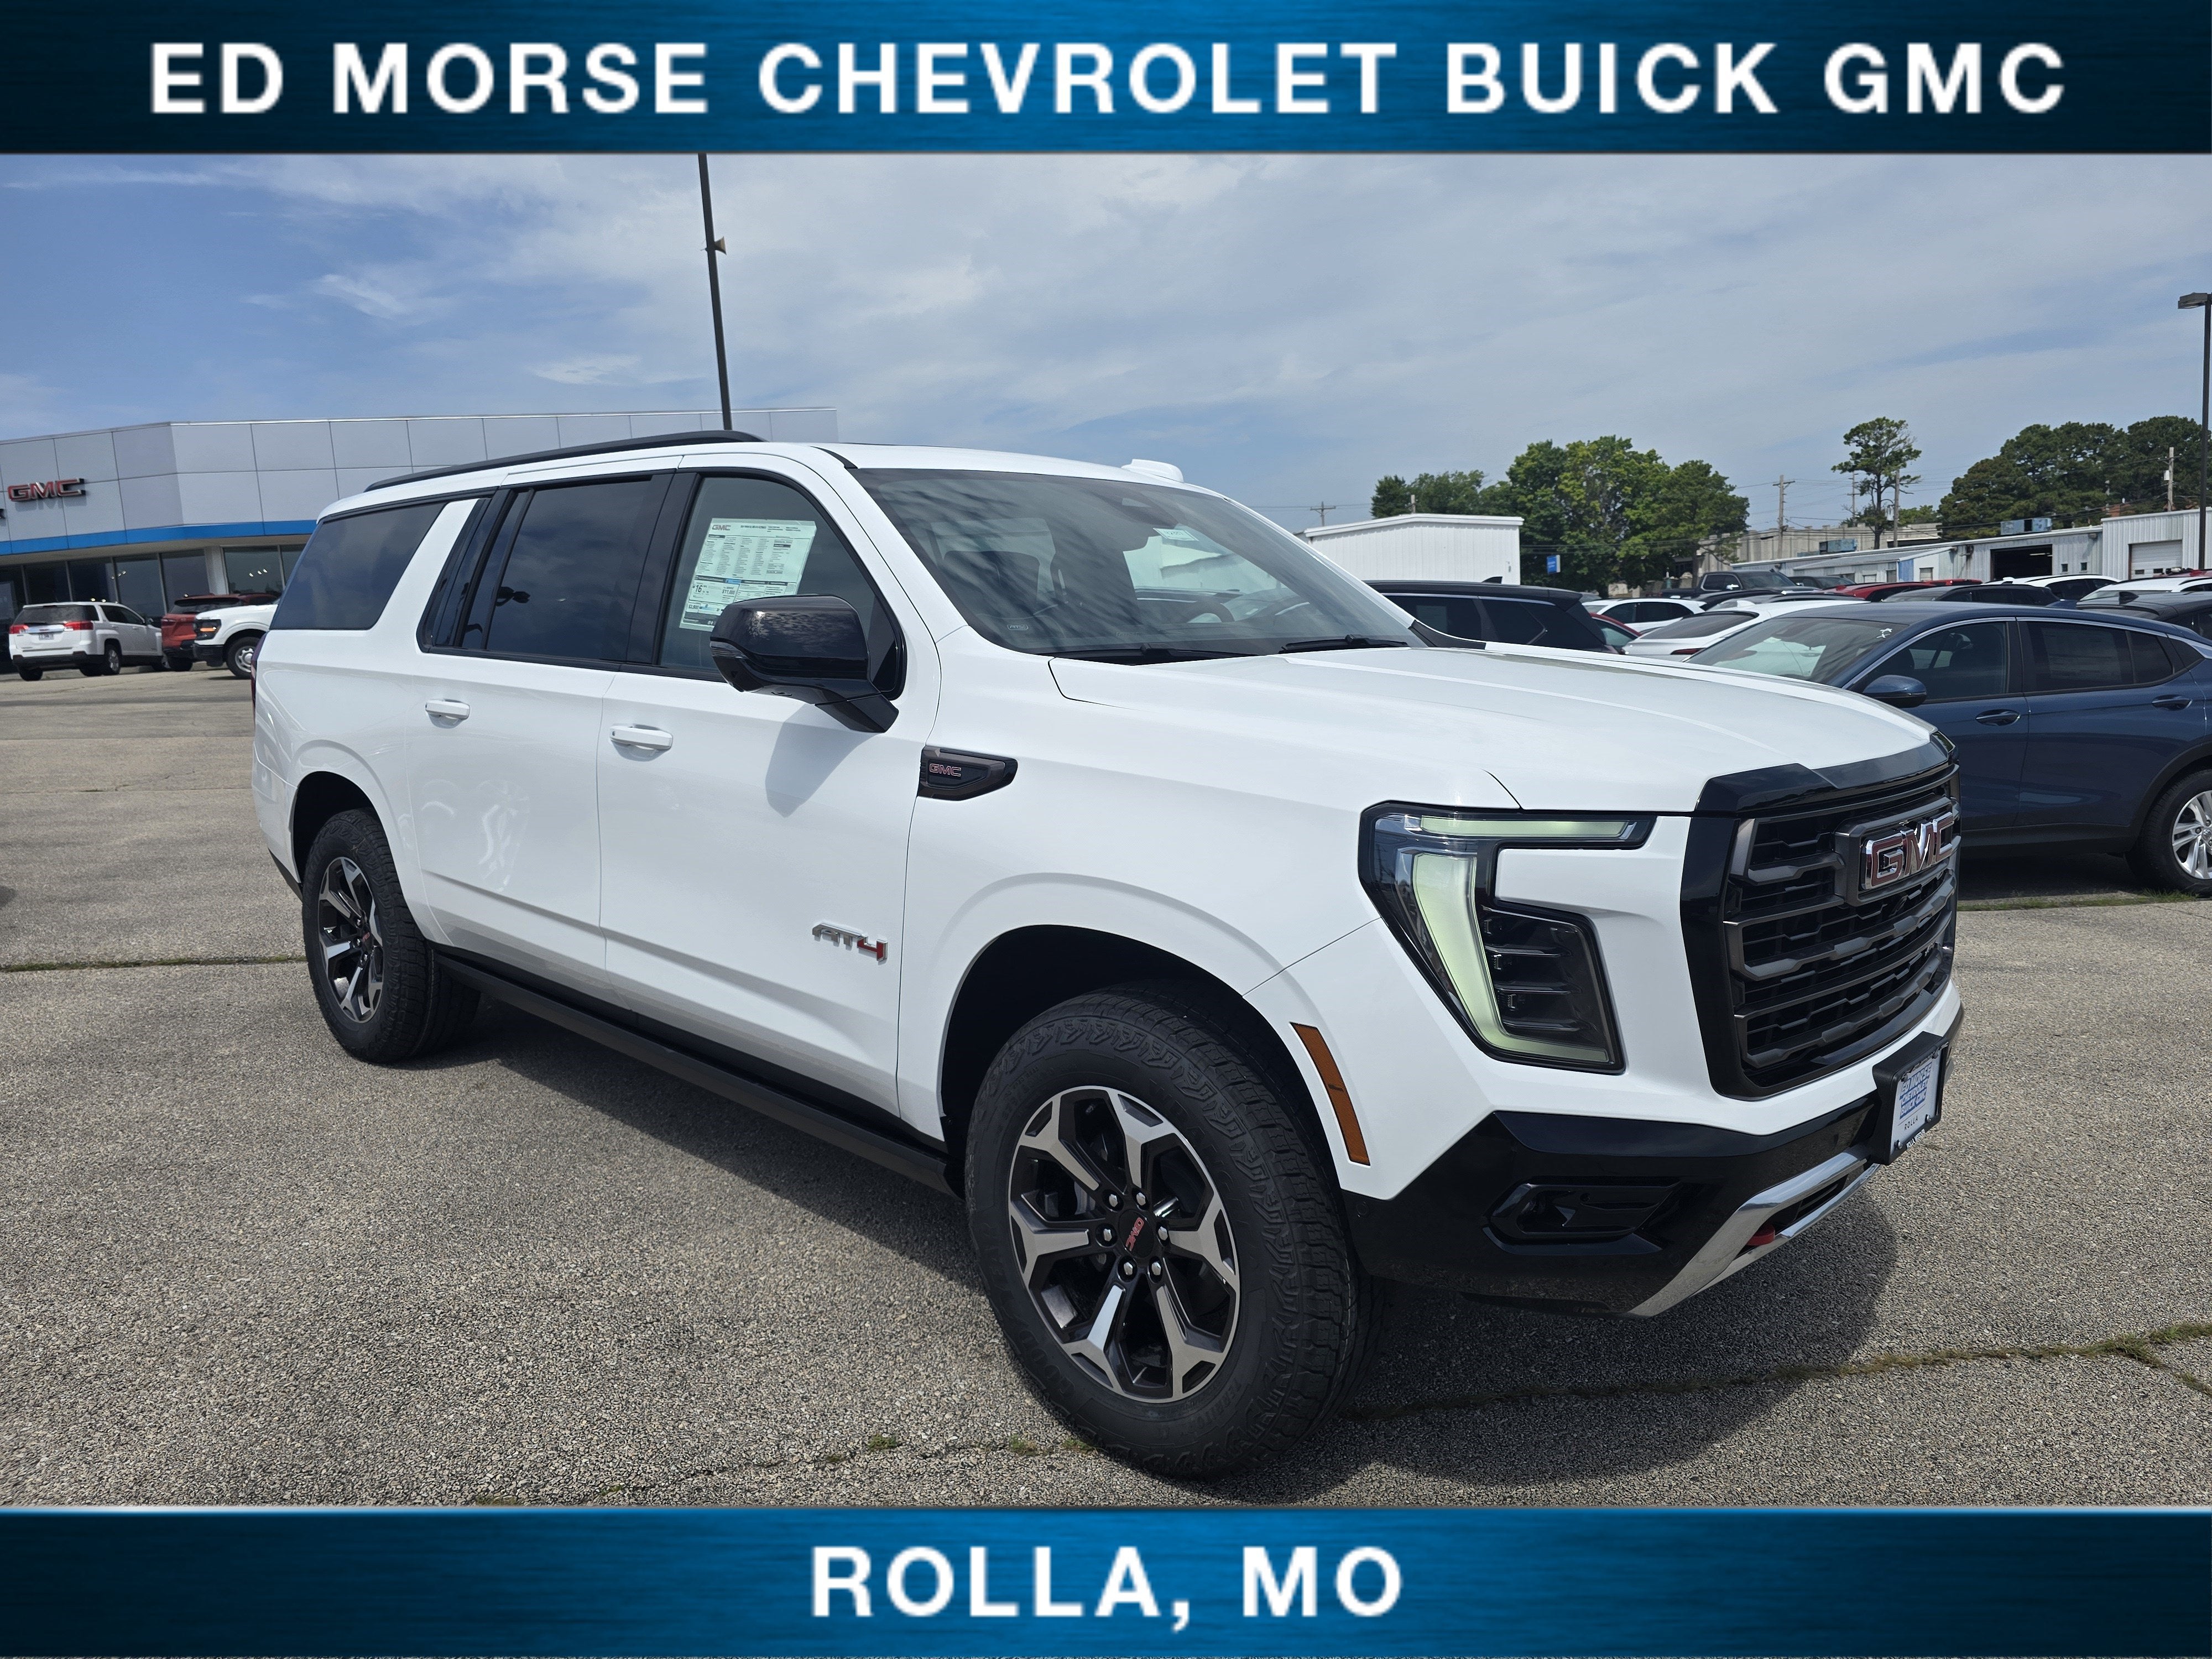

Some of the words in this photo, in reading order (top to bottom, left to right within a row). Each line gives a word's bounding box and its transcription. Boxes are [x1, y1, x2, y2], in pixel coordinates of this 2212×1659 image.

[8, 478, 86, 502] GMC
[929, 763, 962, 777] GMC
[1863, 811, 1954, 890] GMC
[812, 923, 888, 962] AT4
[1901, 1079, 1911, 1093] ED
[1911, 1063, 1932, 1087] MORSE
[1905, 1115, 1918, 1131] ROLLA
[1125, 1217, 1145, 1251] GMC
